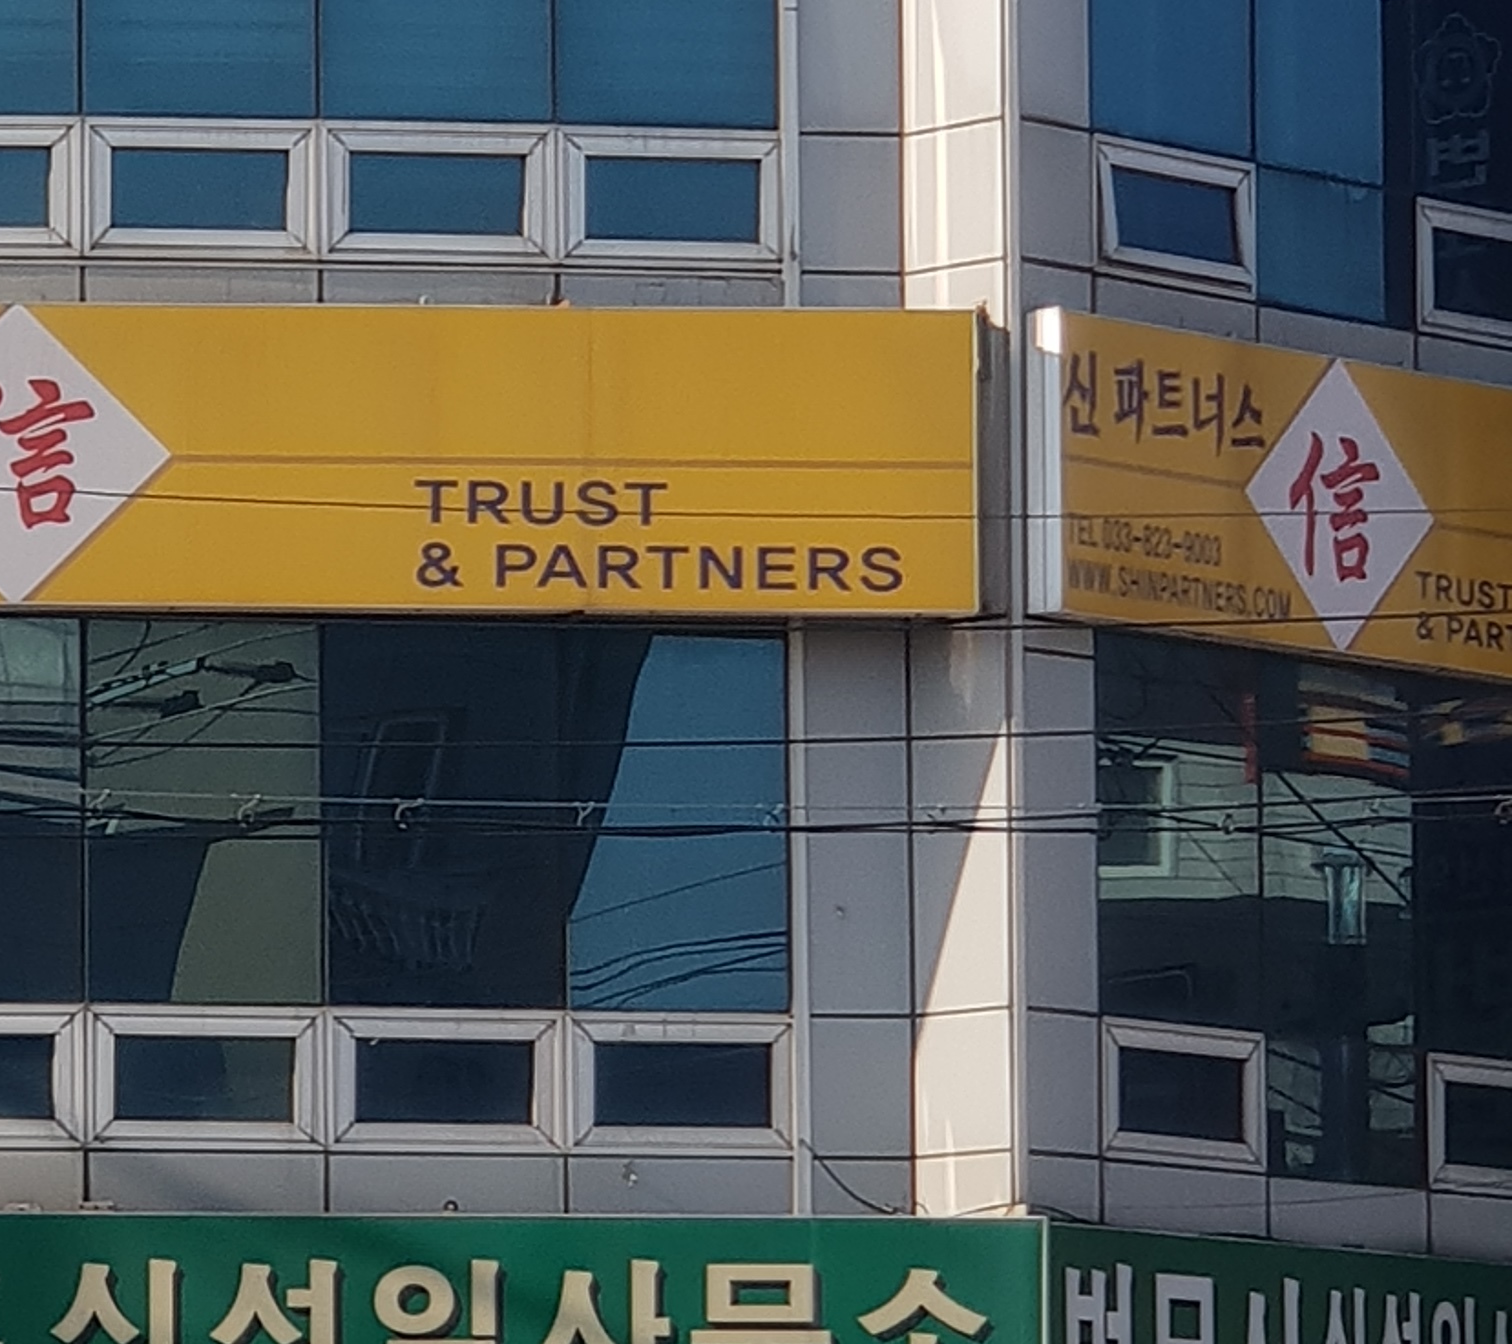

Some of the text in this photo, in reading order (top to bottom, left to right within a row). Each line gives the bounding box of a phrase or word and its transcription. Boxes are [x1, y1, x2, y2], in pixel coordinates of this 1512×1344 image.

[414, 480, 667, 528] TRUST
[1290, 431, 1380, 582] 信
[415, 541, 905, 595] & PARTNERS
